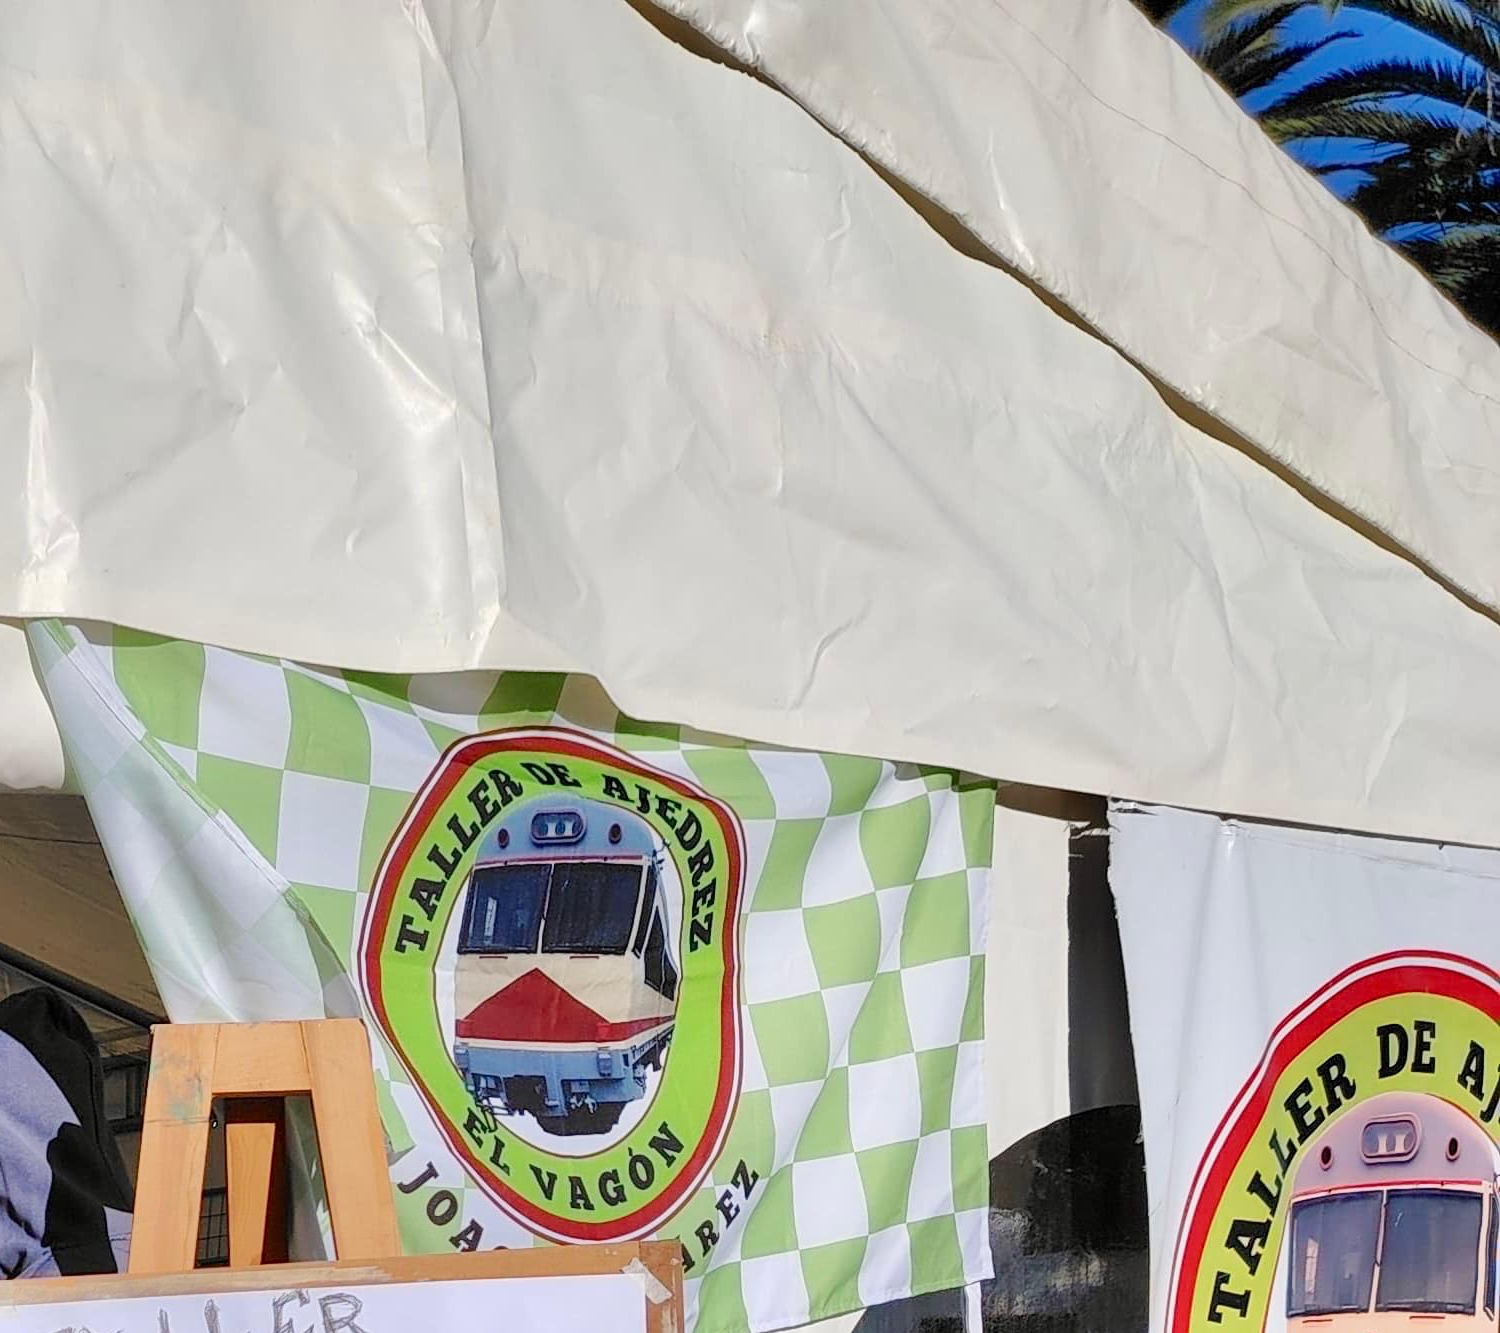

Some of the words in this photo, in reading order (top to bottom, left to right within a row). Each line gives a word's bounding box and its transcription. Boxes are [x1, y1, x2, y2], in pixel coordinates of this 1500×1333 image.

[395, 768, 524, 952] TALLER
[520, 761, 583, 788] DE
[601, 773, 717, 952] AJEDREZ
[398, 1160, 508, 1252] JOA
[463, 1106, 511, 1176] EL
[528, 1120, 685, 1211] VAGÓN
[1207, 1052, 1357, 1324] TALLER
[1376, 1019, 1436, 1080] DE
[1457, 1039, 1500, 1123] AJ
